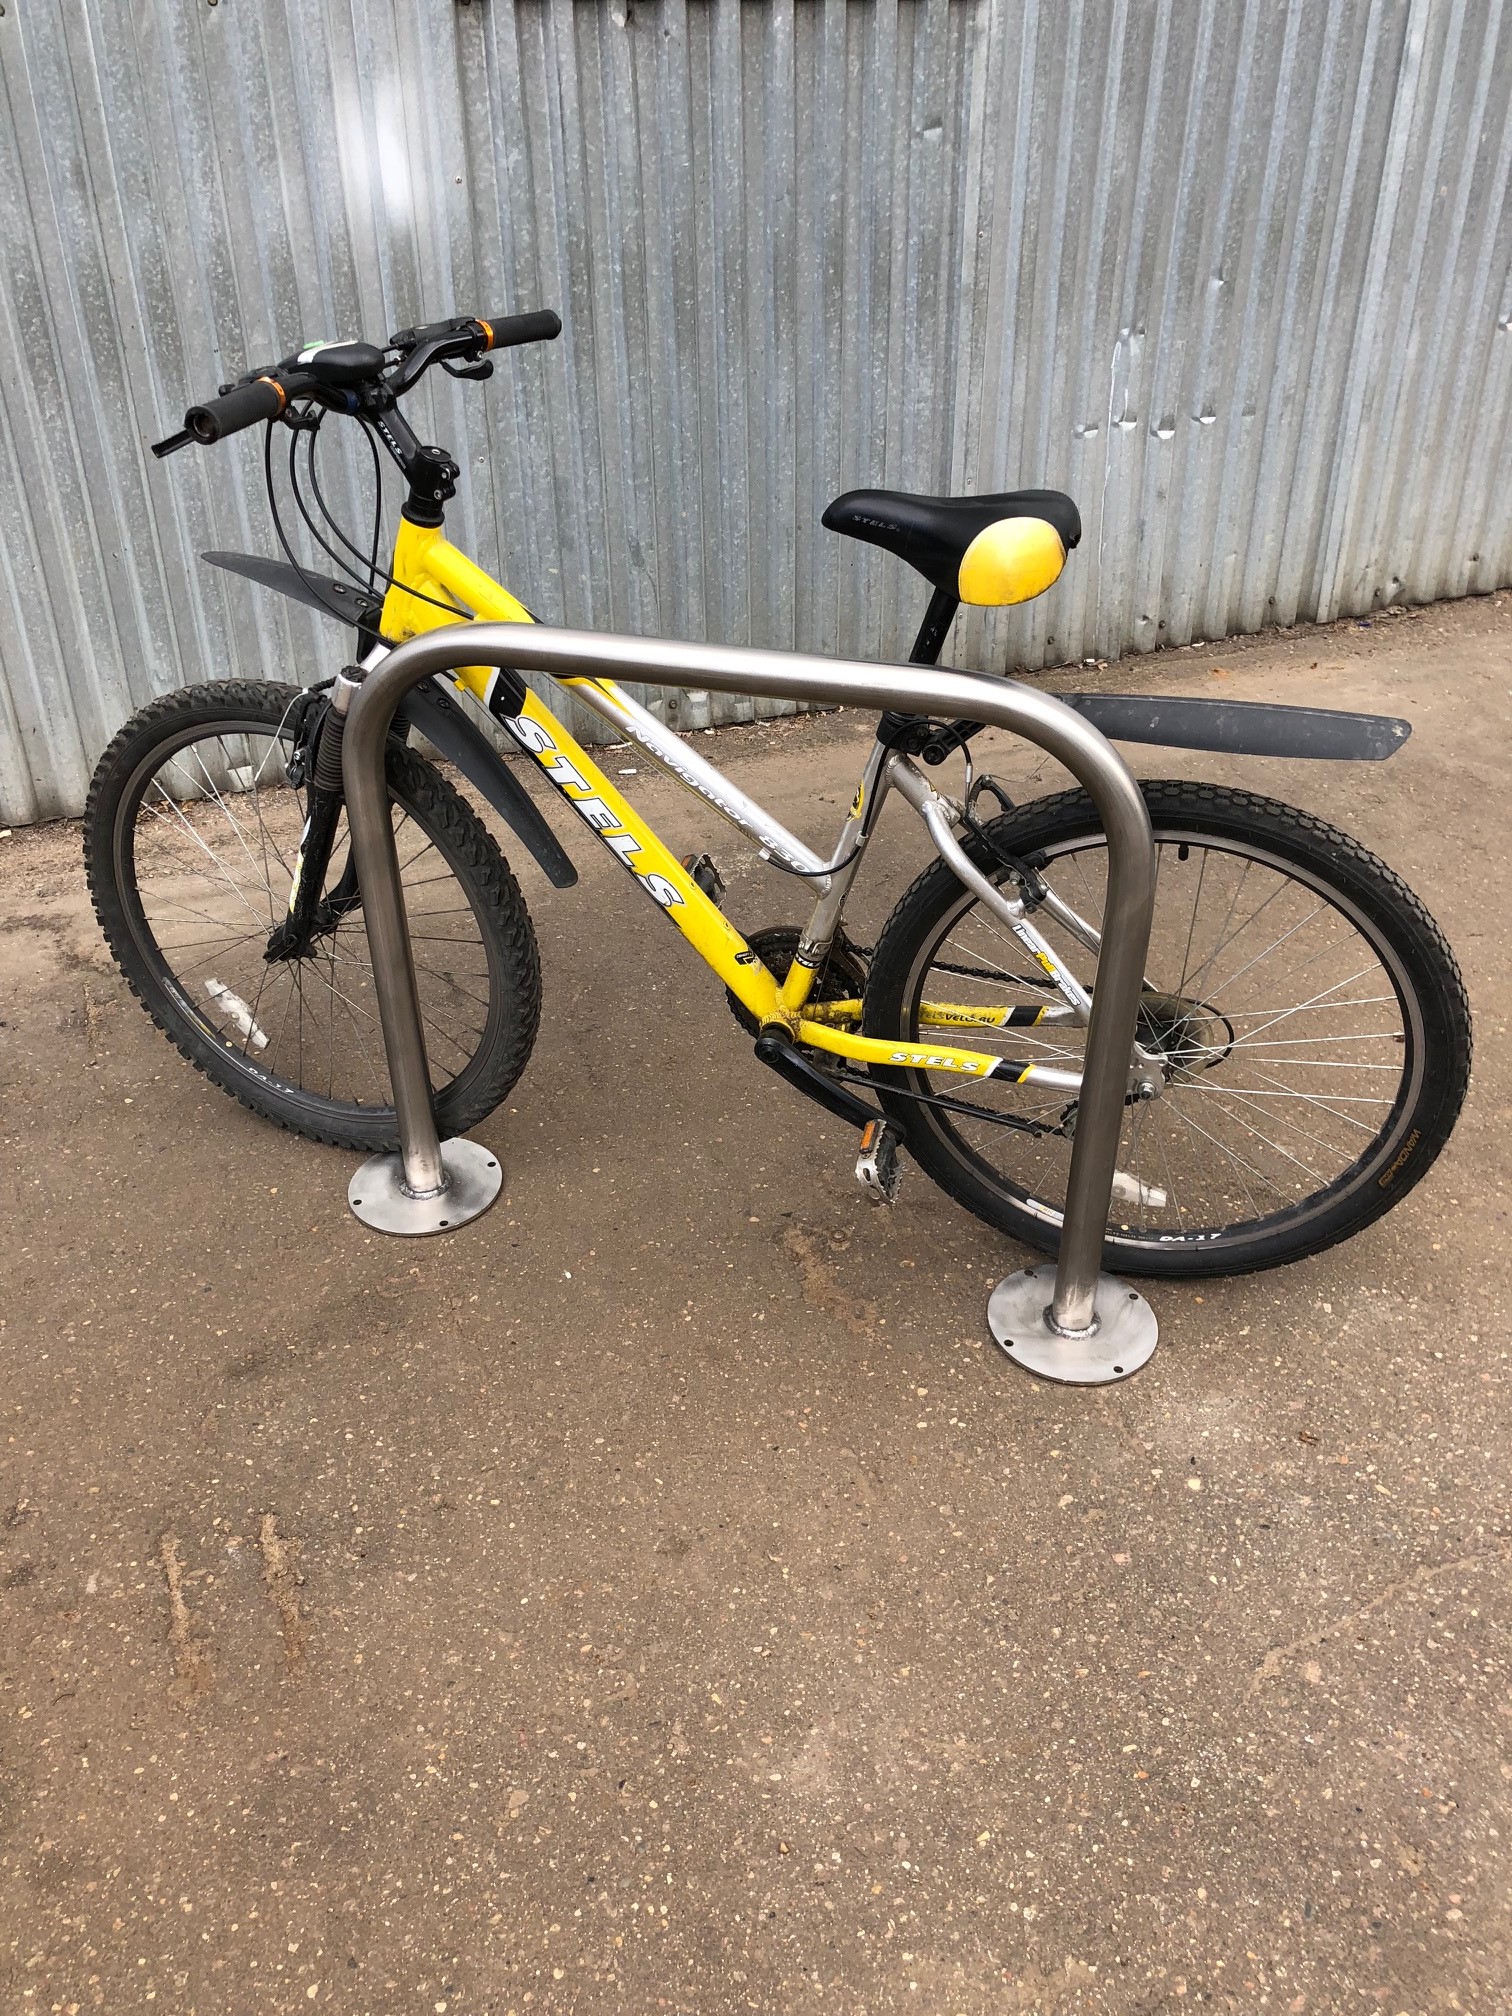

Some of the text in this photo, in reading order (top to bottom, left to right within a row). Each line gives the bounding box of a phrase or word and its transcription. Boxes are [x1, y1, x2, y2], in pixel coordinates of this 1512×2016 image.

[378, 421, 403, 455] STELS
[852, 515, 897, 530] STELS
[503, 715, 685, 907] STELS
[625, 725, 811, 873] Navigator 830
[889, 1052, 979, 1072] STELS
[1396, 1128, 1421, 1166] WANDA
